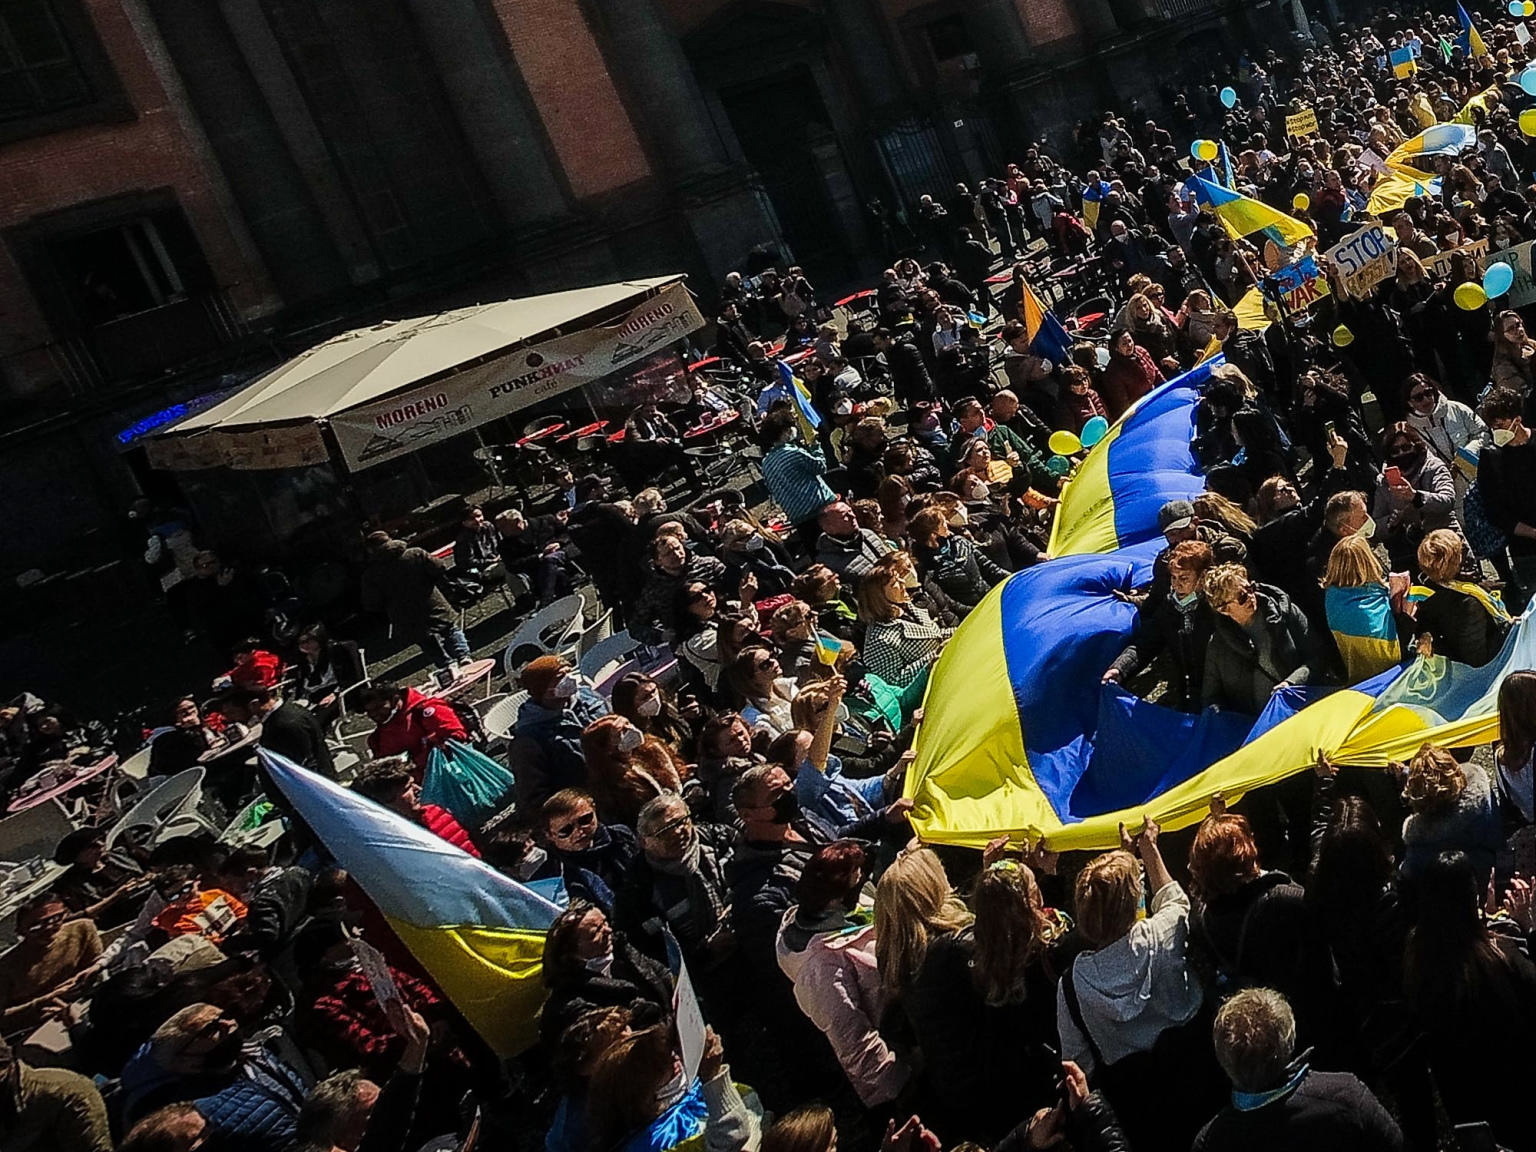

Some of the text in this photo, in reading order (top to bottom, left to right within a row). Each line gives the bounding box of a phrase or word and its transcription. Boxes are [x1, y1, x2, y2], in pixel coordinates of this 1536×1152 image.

[1335, 226, 1386, 278] STOP
[618, 303, 673, 338] MORENO
[376, 393, 449, 429] MORENO
